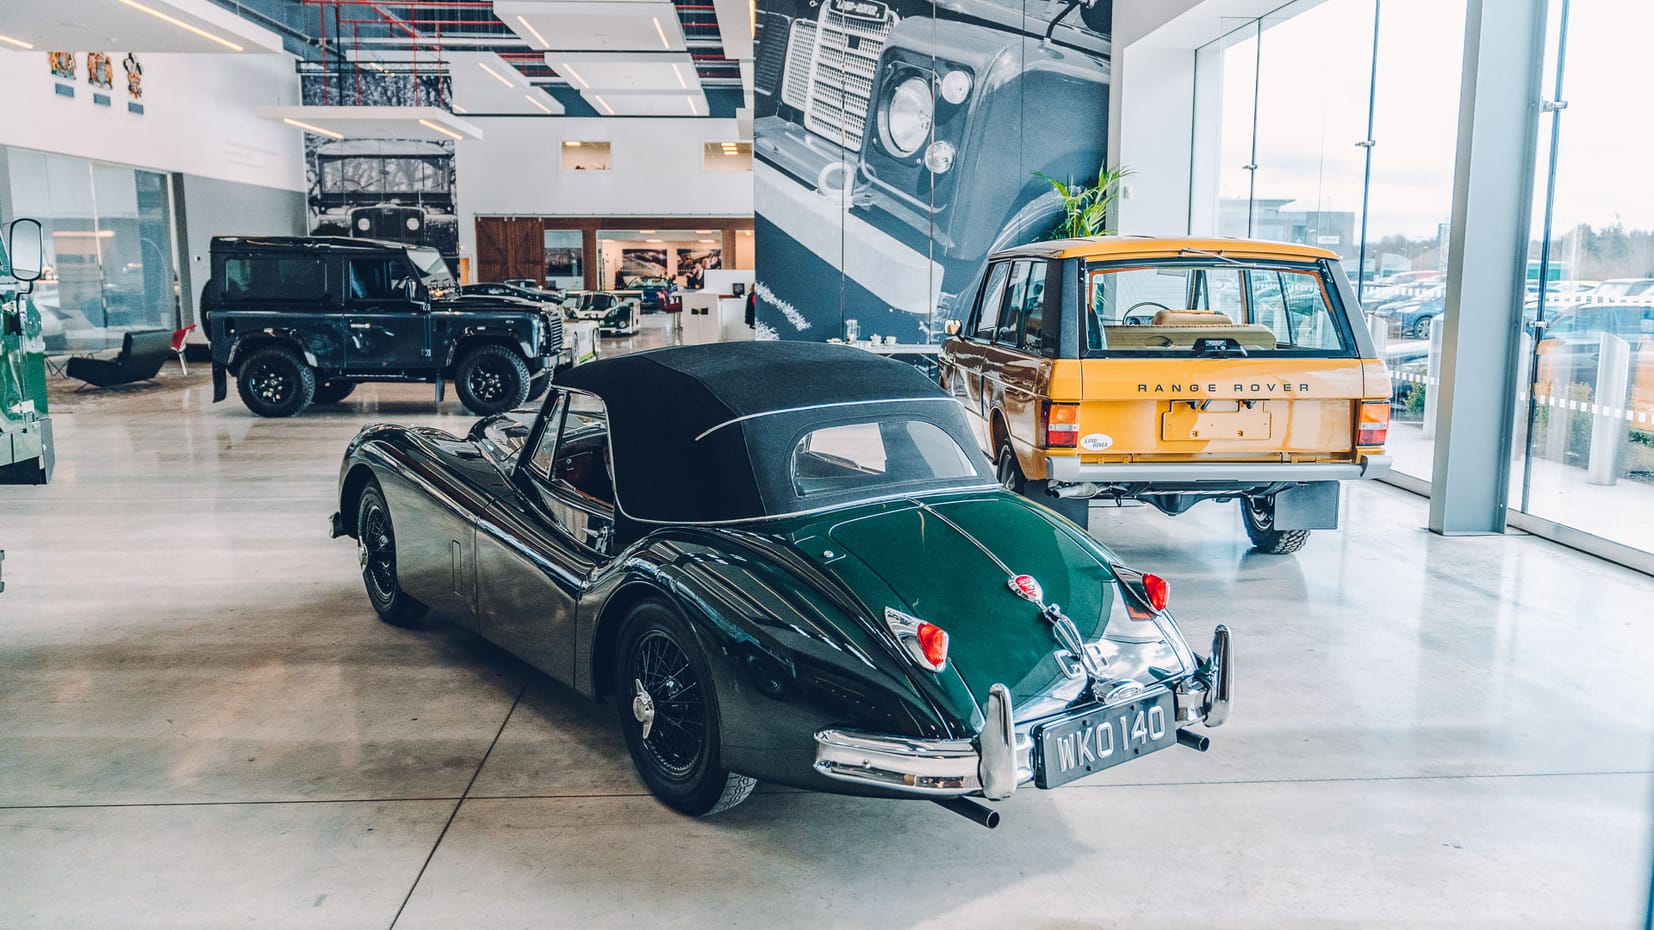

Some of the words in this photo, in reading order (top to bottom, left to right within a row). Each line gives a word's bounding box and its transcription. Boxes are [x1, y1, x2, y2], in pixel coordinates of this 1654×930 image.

[1137, 383, 1216, 393] RANGE
[1234, 382, 1309, 393] ROVER
[1056, 722, 1114, 772] WKO
[1119, 705, 1166, 751] 140
